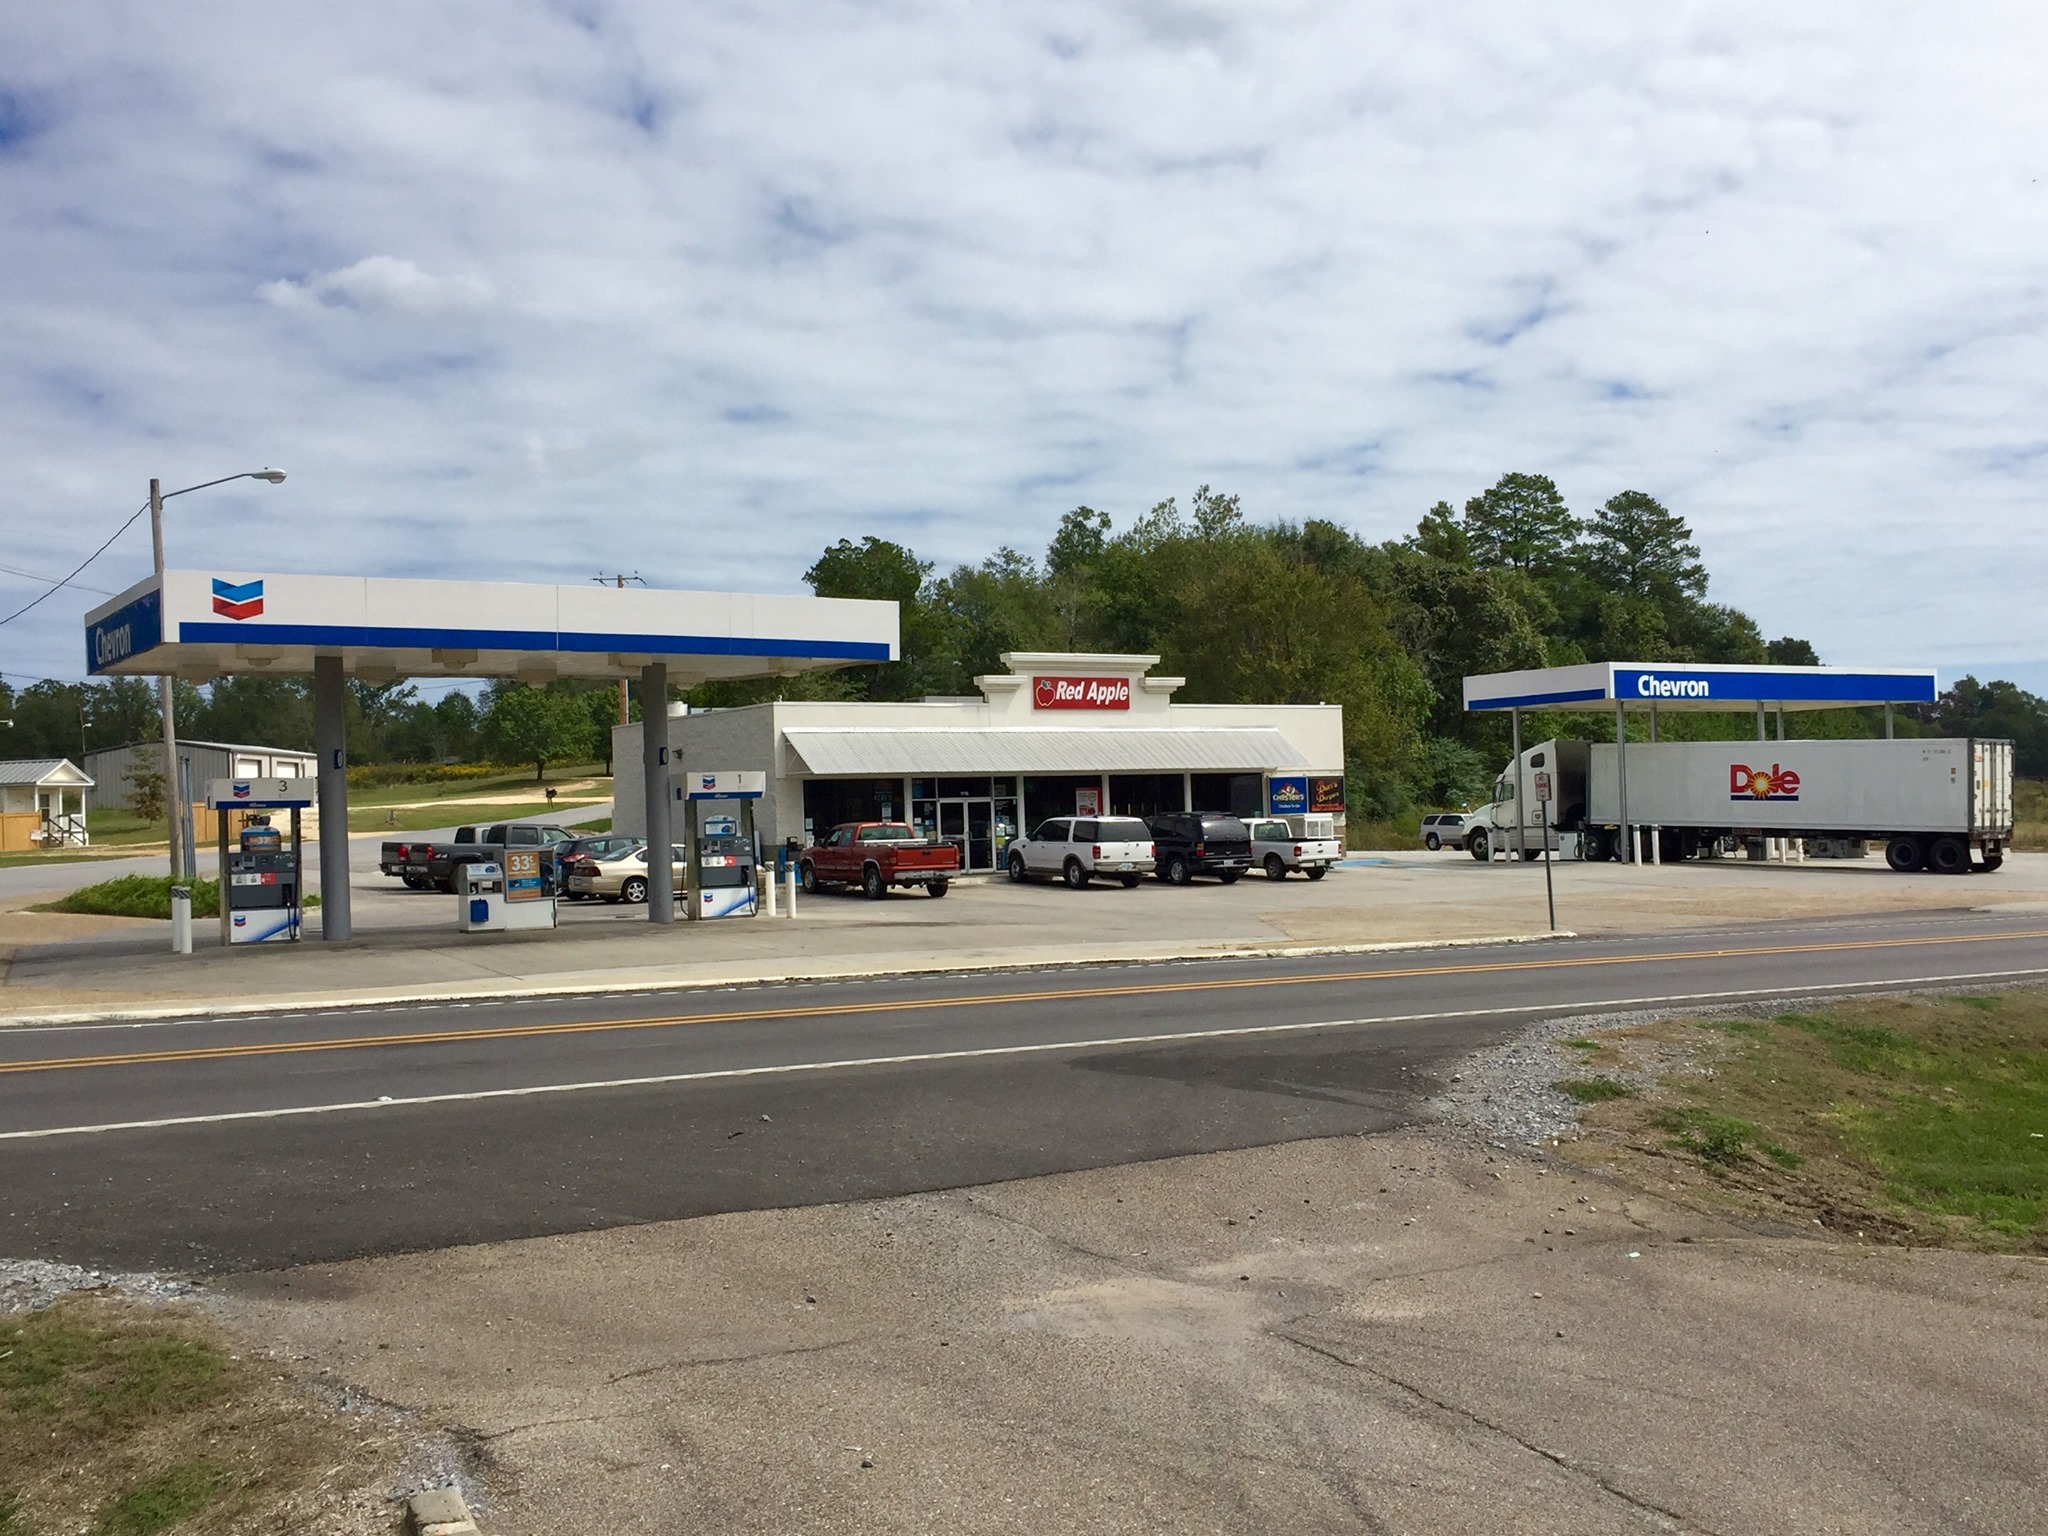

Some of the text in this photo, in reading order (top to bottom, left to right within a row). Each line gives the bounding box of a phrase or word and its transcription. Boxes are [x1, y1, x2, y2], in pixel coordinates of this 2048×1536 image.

[95, 623, 132, 665] Chevron
[1055, 680, 1128, 705] Red Apple
[1637, 674, 1709, 697] Chevron
[278, 780, 288, 792] 3
[737, 773, 743, 784] 1
[1730, 763, 1801, 797] Dole
